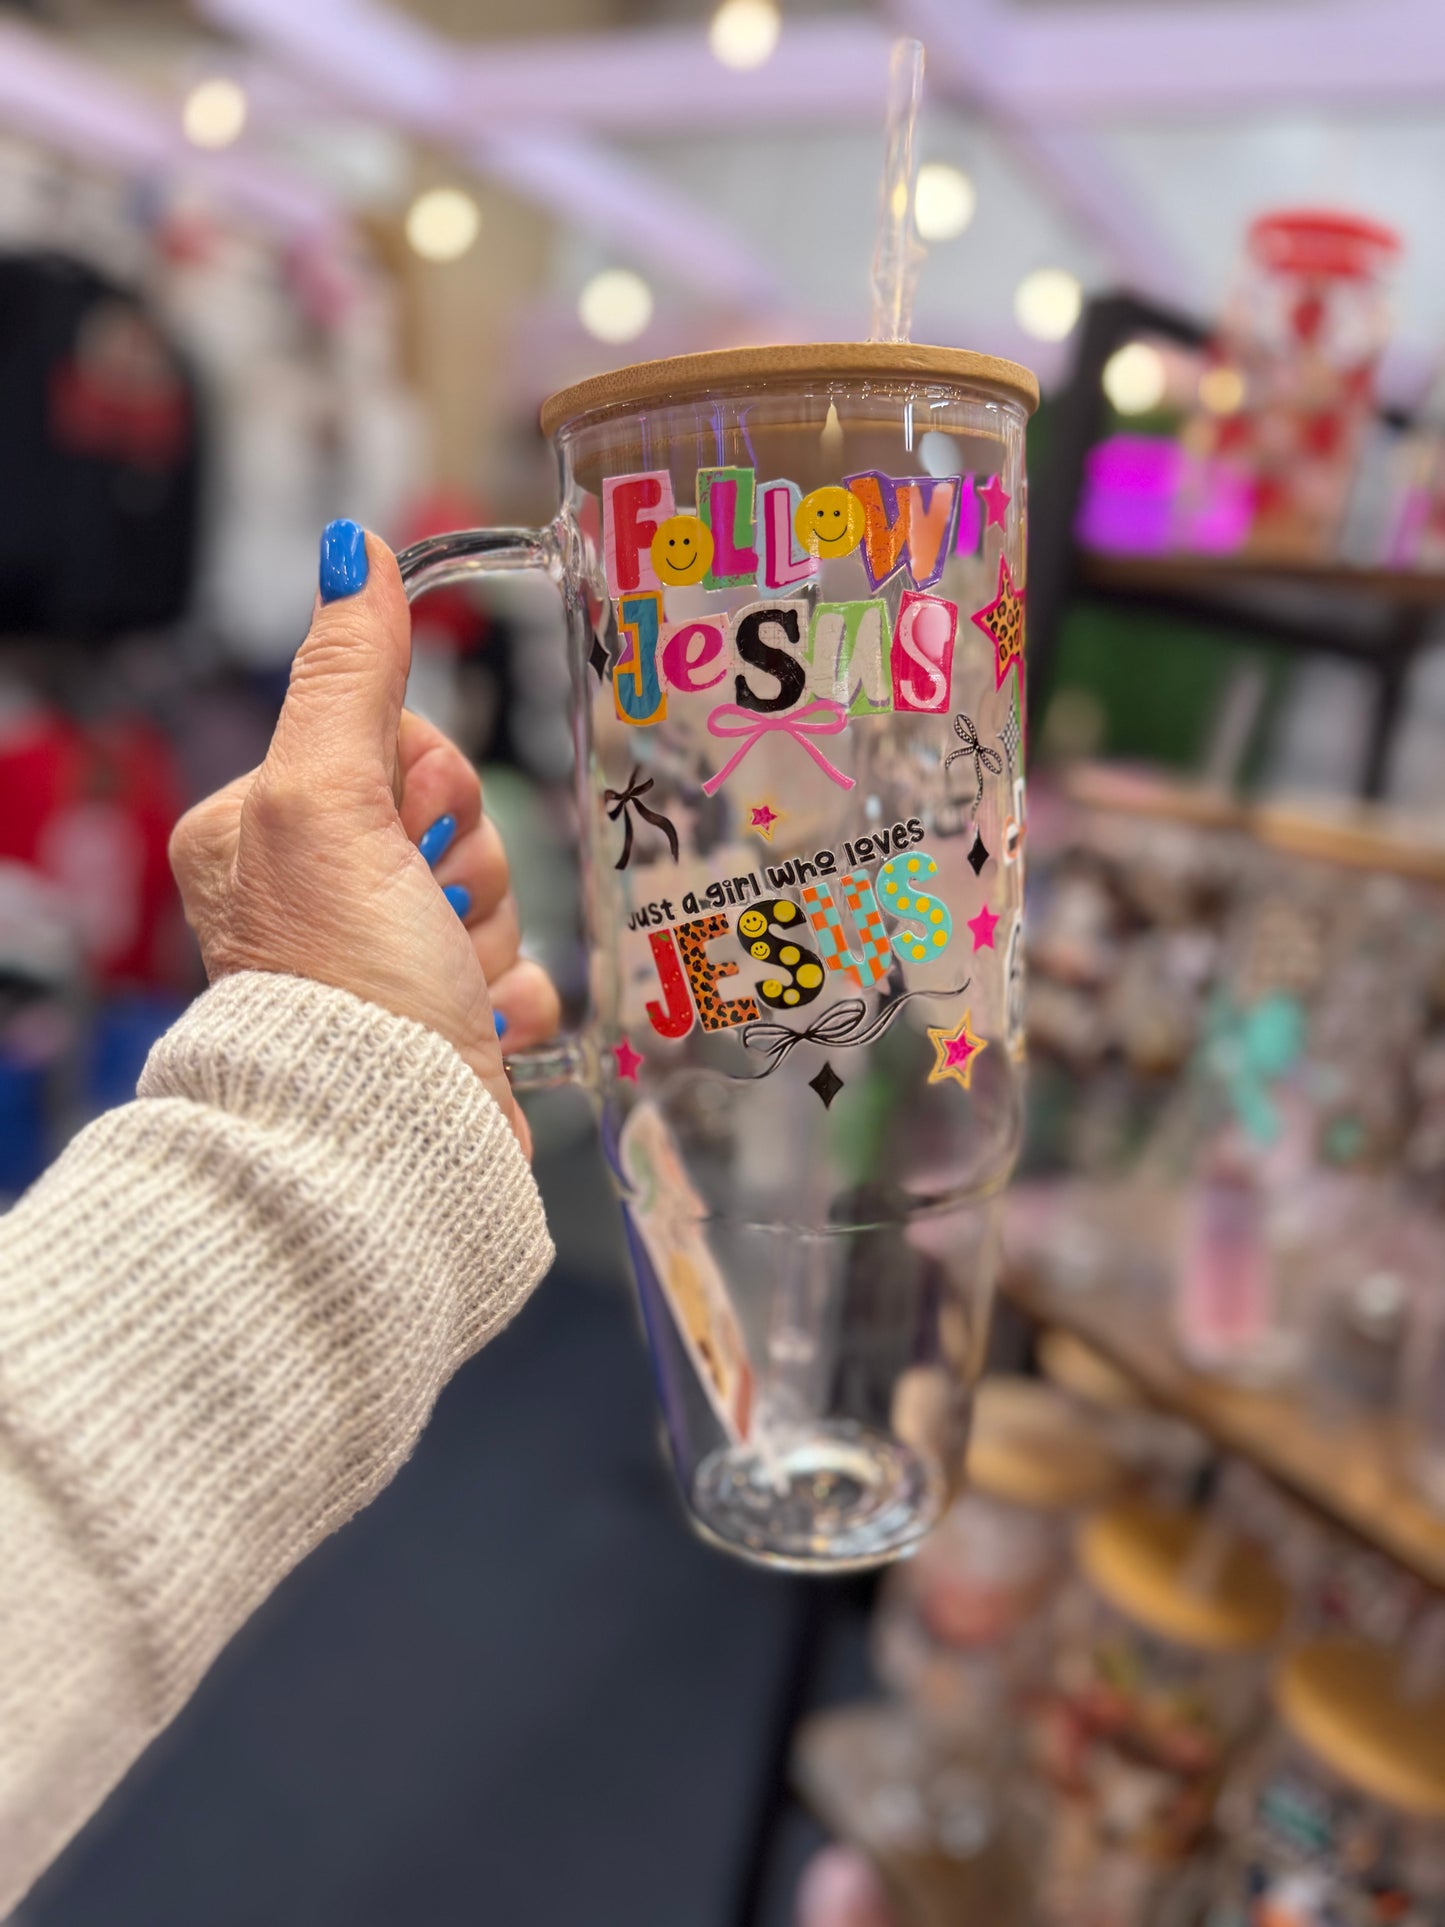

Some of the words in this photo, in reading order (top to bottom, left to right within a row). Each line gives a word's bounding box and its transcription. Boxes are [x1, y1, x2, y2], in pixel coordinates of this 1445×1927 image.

[682, 892, 700, 914] a
[706, 873, 761, 908] girl
[844, 818, 925, 866] loves
[645, 851, 953, 1039] JESUS
